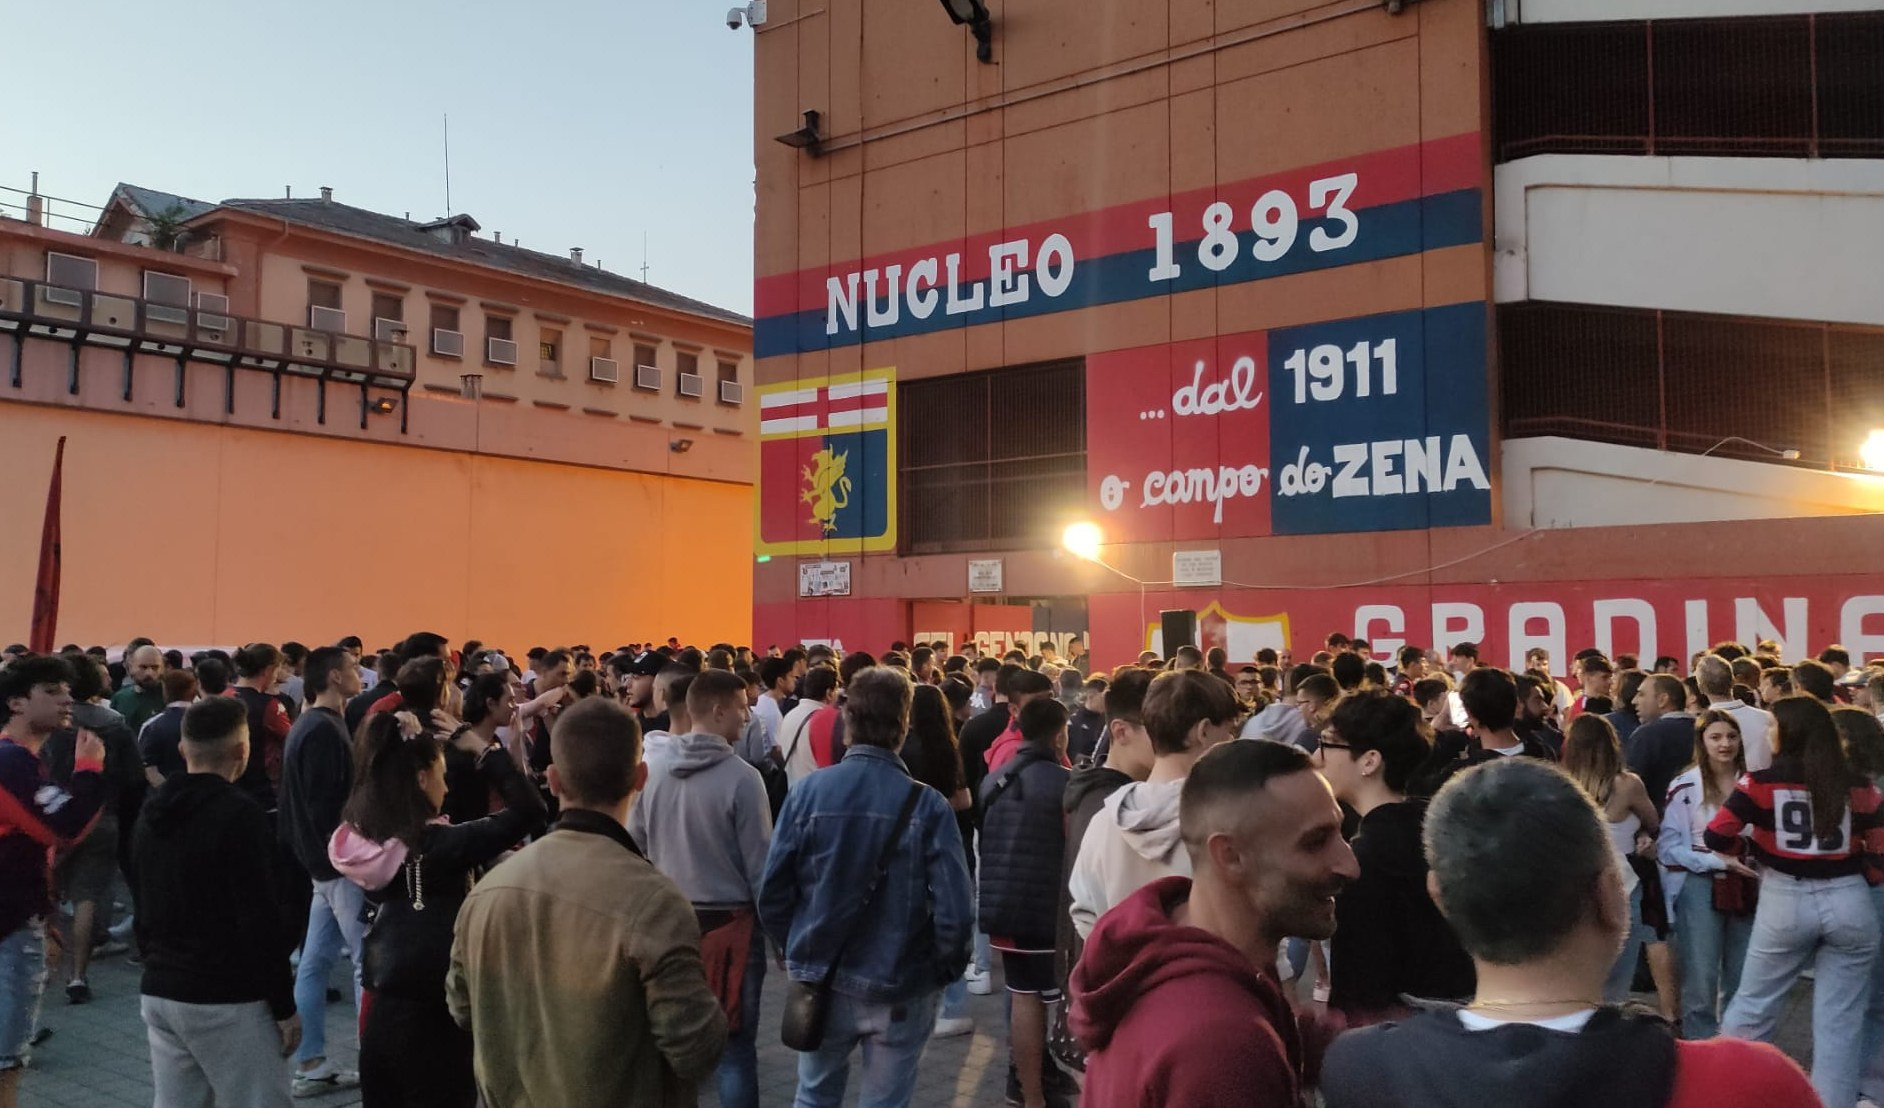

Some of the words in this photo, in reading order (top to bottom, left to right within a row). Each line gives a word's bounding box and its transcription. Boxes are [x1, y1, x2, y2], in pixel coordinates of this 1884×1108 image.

[827, 233, 1075, 335] NUCLEO
[1148, 172, 1359, 283] 1893
[1284, 337, 1397, 404] 1911
[1139, 464, 1269, 524] campo
[1332, 433, 1492, 498] ZENA
